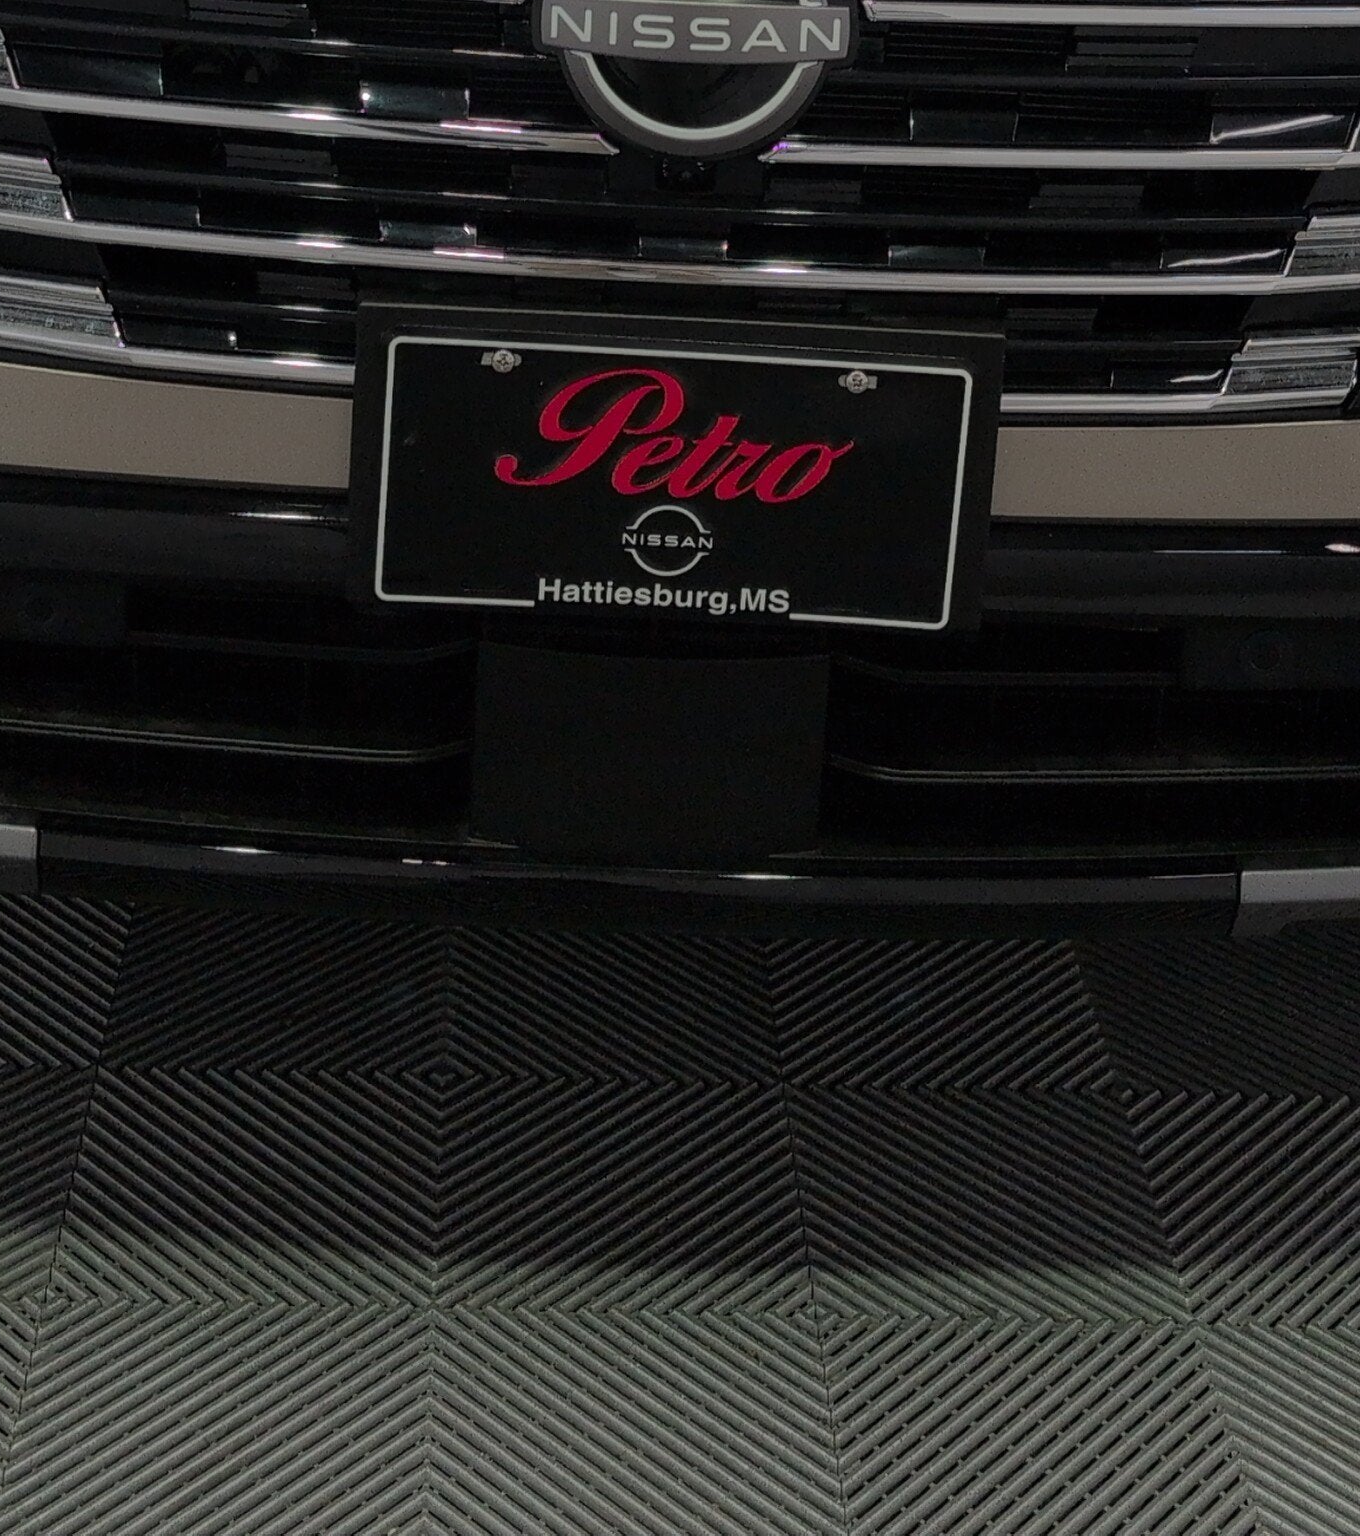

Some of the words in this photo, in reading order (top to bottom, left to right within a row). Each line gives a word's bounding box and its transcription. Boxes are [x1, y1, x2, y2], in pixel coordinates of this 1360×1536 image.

[549, 4, 842, 53] NISSAN
[494, 368, 854, 504] Petro
[621, 532, 714, 550] NISSAN
